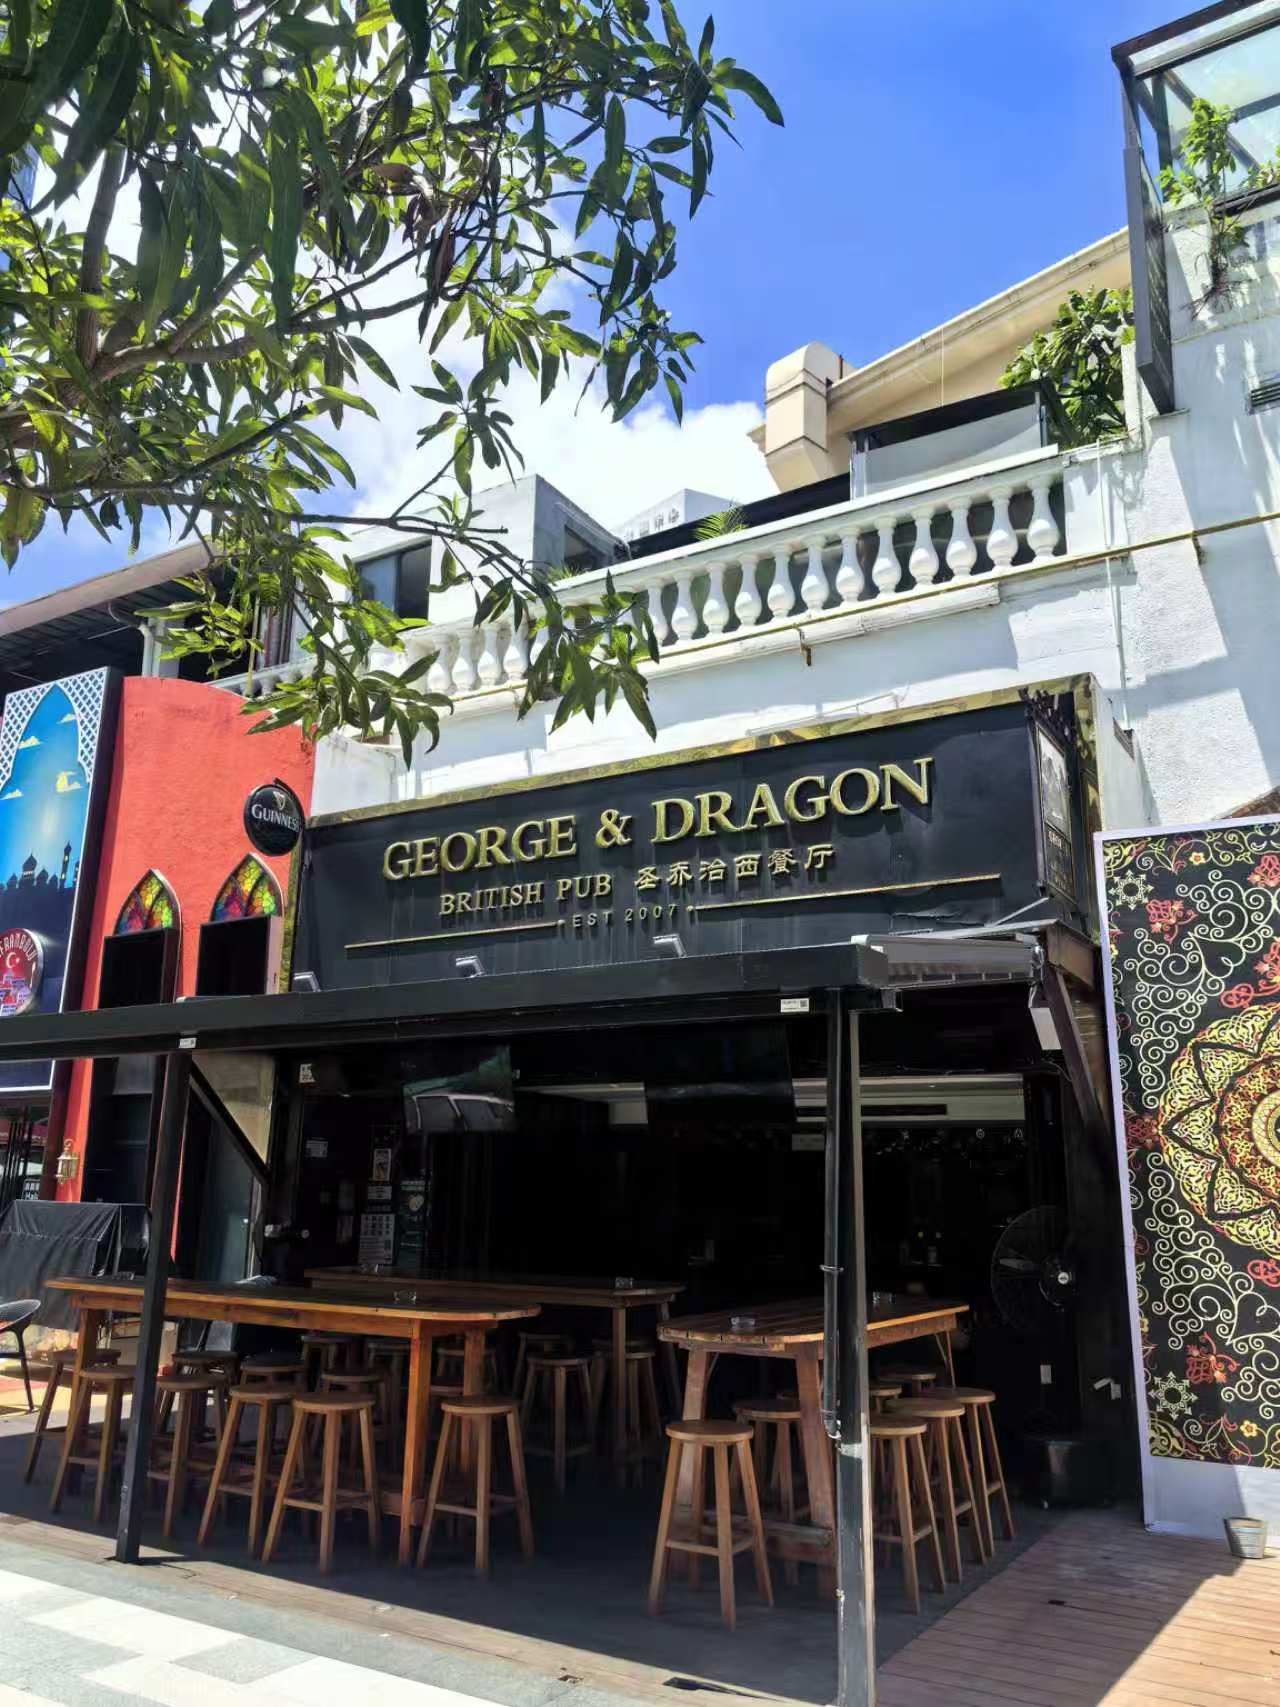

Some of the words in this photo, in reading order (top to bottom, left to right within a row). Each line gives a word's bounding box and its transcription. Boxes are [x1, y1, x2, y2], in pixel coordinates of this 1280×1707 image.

[383, 815, 577, 880] GEORGE
[595, 809, 633, 848] &
[651, 757, 934, 844] DRAGON
[634, 844, 834, 890] 圣乔治西餐厅
[439, 881, 544, 916] BRITISH
[556, 873, 612, 901] PUB
[572, 910, 614, 927] EST
[624, 904, 678, 922] 2007
